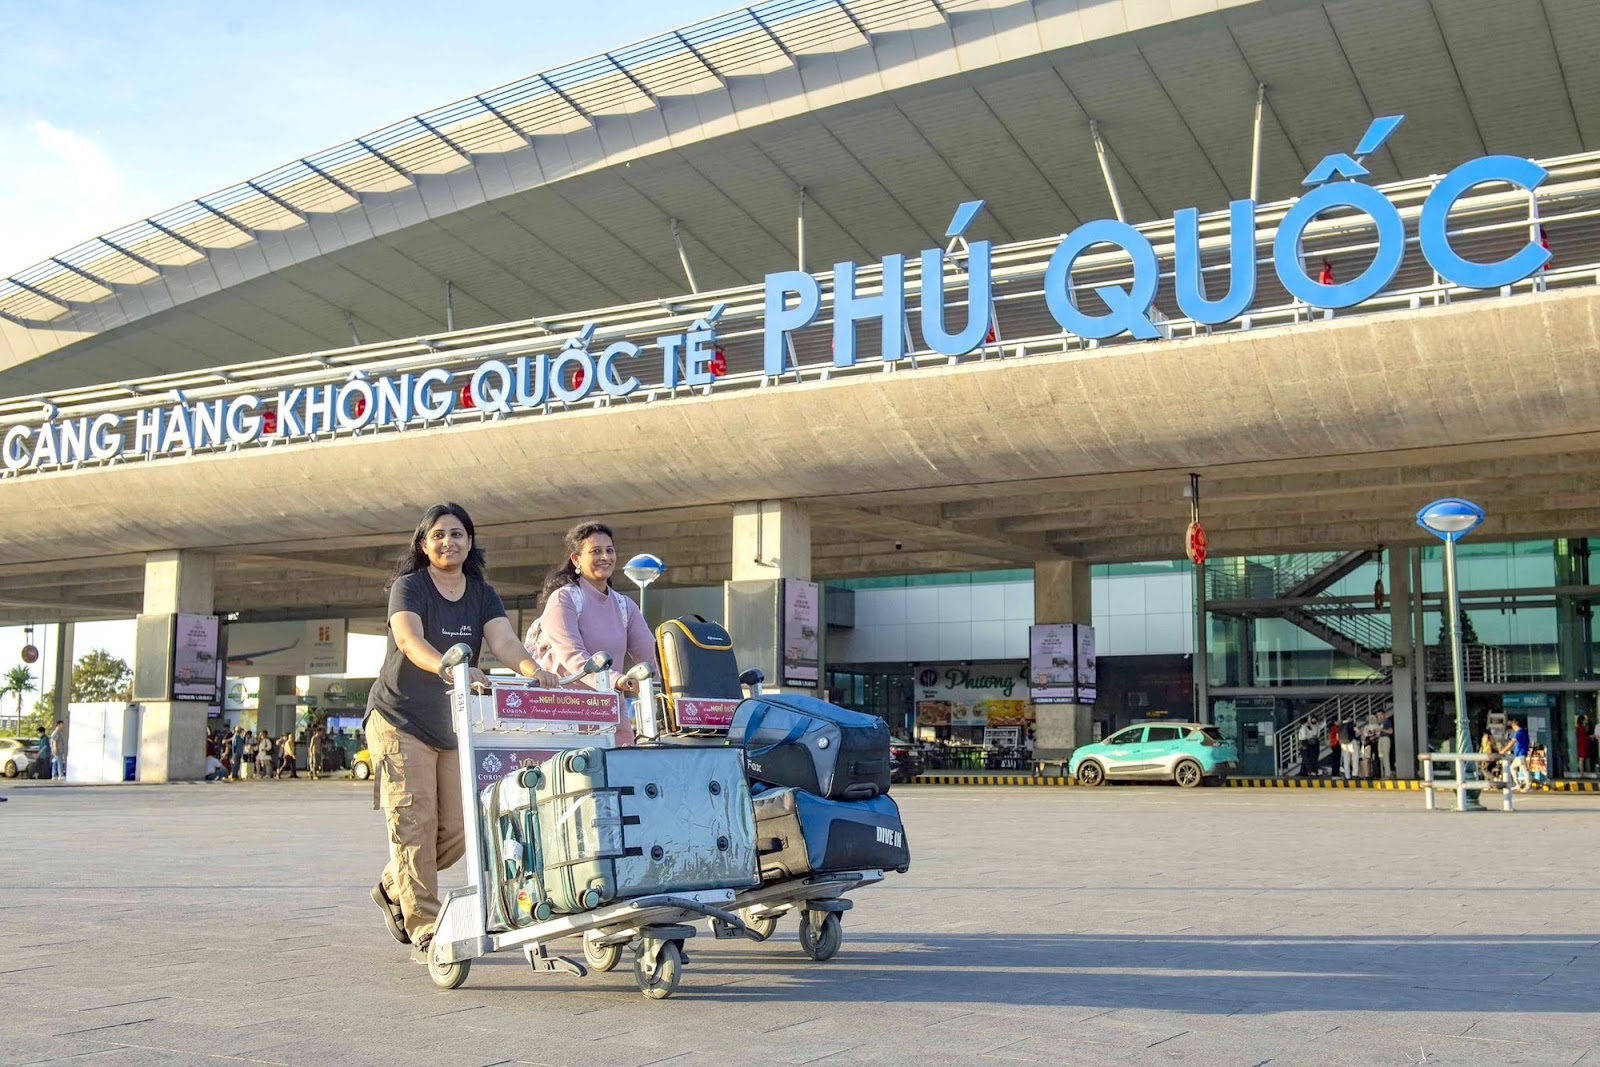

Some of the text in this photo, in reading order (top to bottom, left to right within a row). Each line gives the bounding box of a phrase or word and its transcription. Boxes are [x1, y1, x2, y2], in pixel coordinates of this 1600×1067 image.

[2, 114, 1552, 471] CẢNG HÀNG KHÔNG QUỐC TẾ PHÚ QUỐC
[876, 826, 894, 845] DIVE
